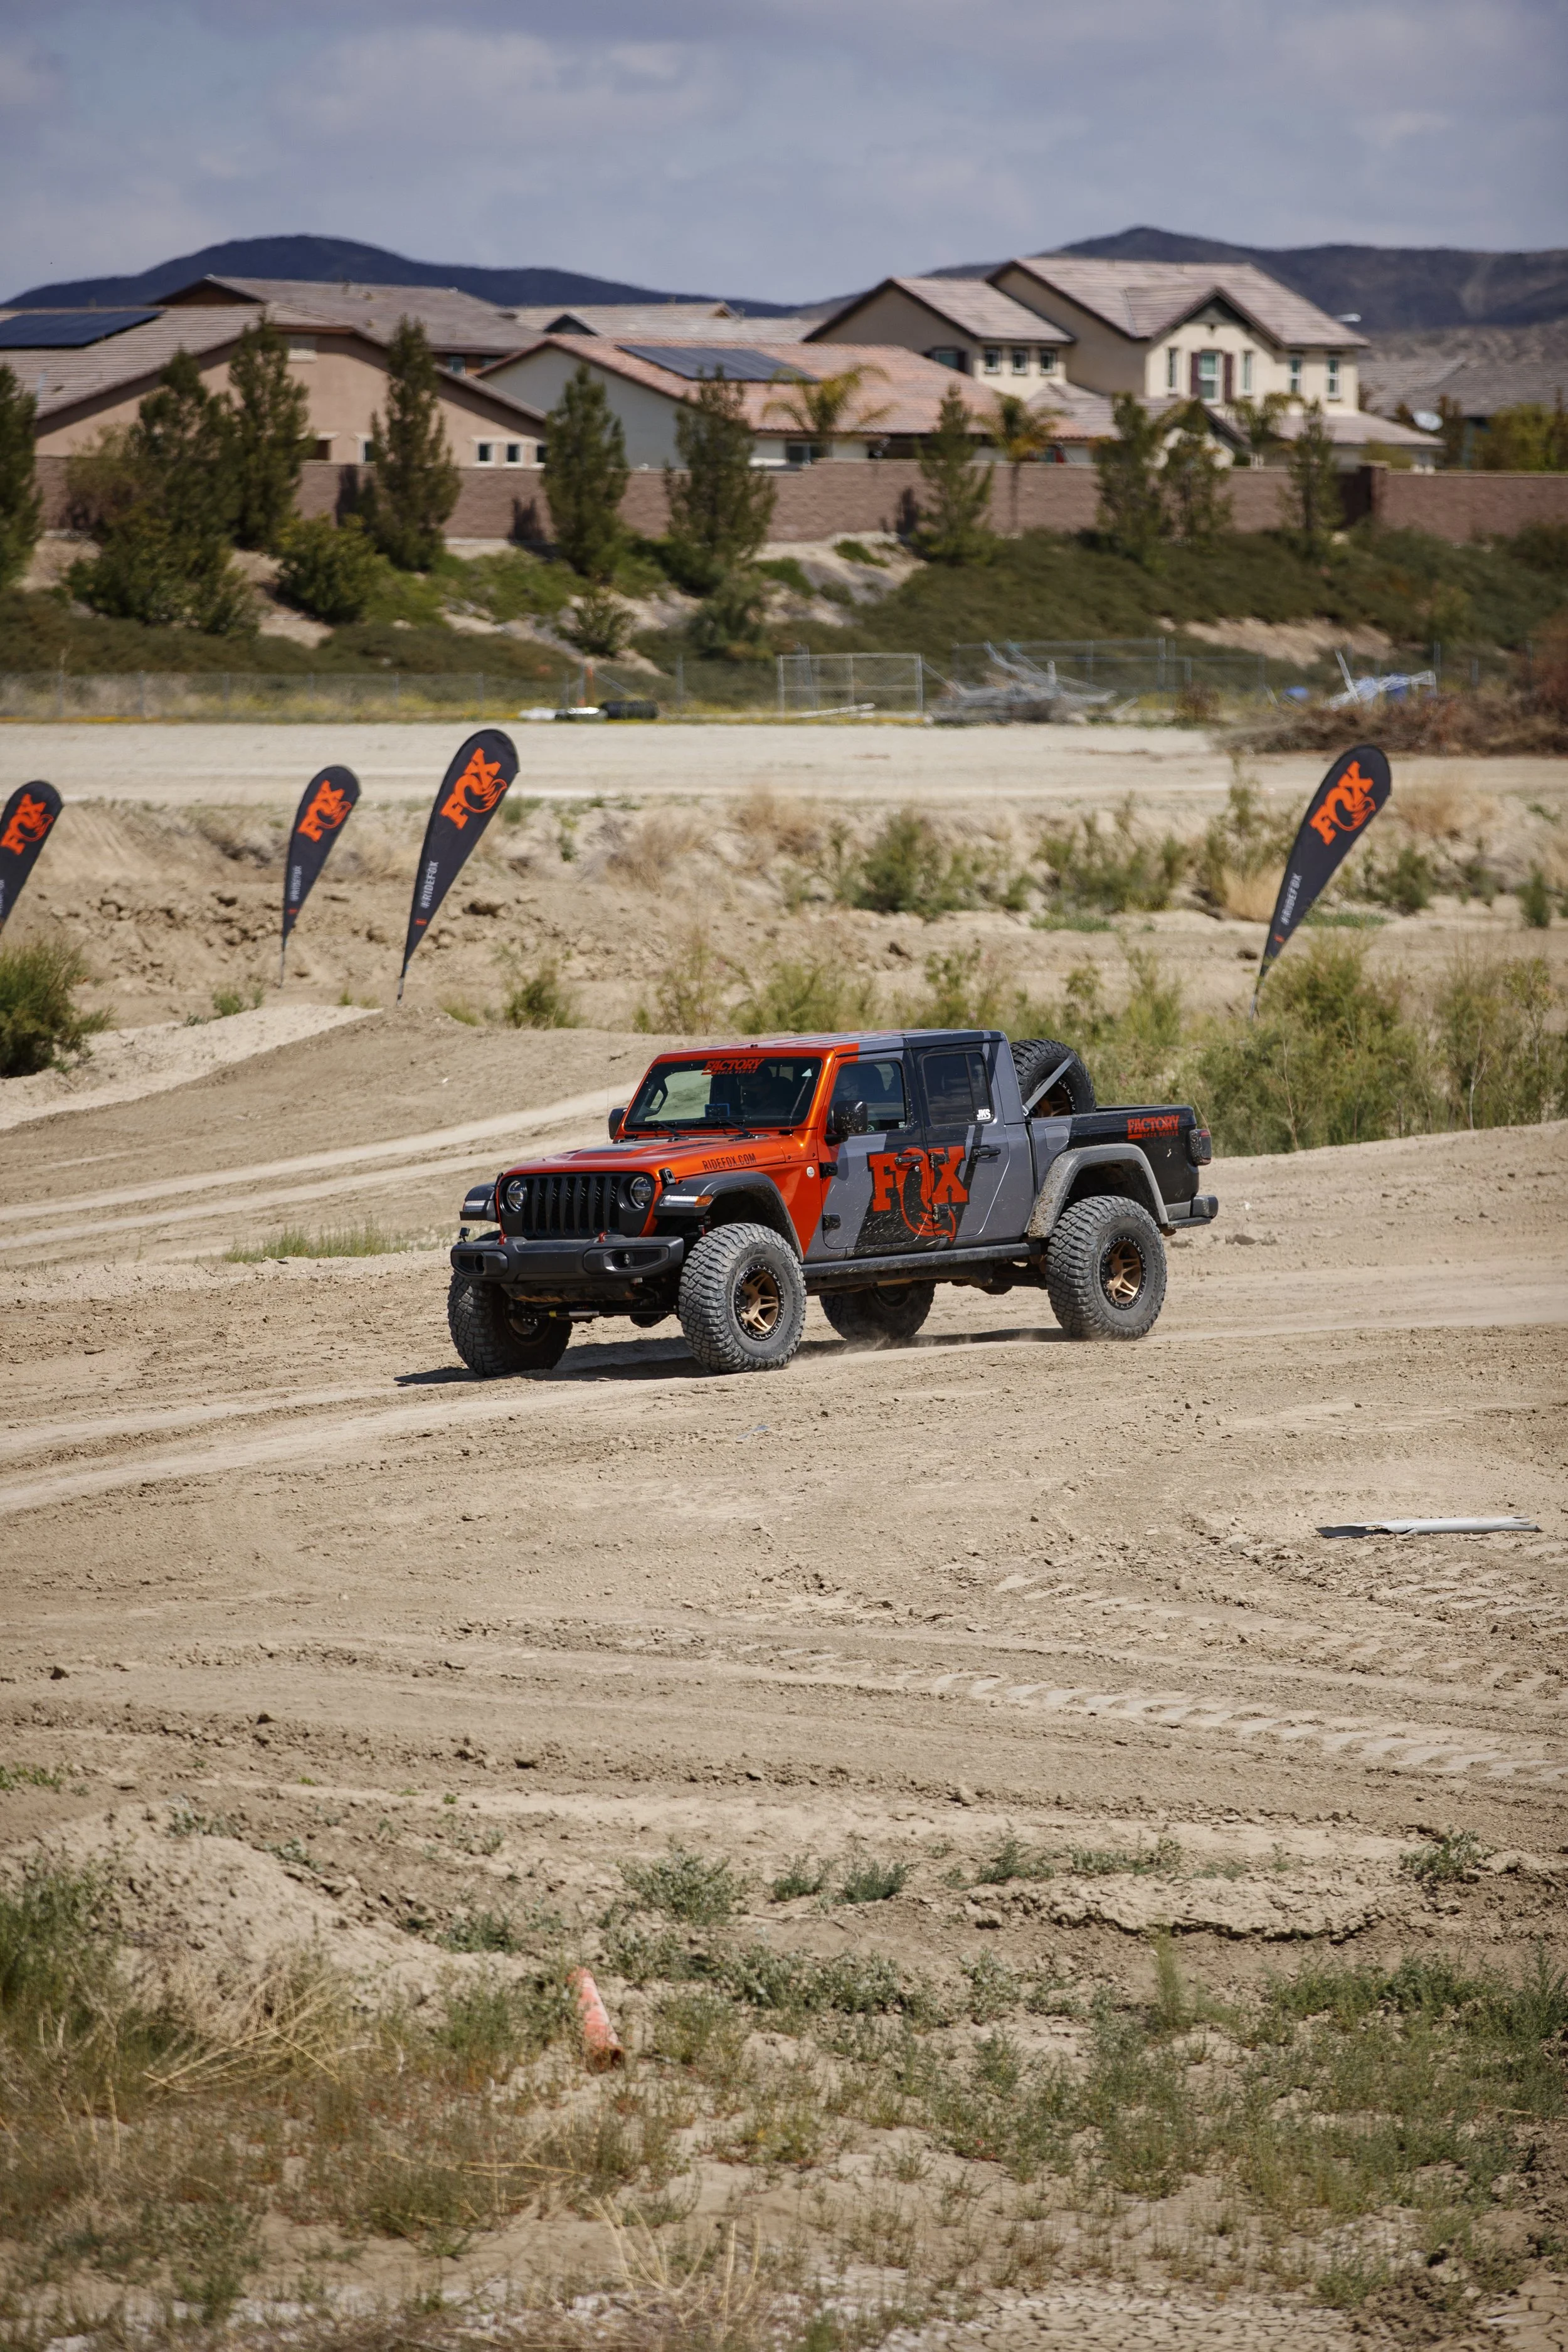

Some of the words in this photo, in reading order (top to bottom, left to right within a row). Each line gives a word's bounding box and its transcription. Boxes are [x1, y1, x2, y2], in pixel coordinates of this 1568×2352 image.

[298, 780, 352, 842] FOX
[440, 747, 507, 830] FOX
[1309, 760, 1376, 845] FOX
[1, 793, 54, 856] FOX
[421, 861, 439, 909] #RIDEFOX
[1280, 872, 1303, 926] #RIDEFOX
[703, 1058, 765, 1071] FACTORY
[977, 1108, 991, 1118] JKS
[1127, 1115, 1180, 1133] FACTORY
[702, 1153, 757, 1171] RIDEFOX.COM
[869, 1145, 968, 1241] FOX
